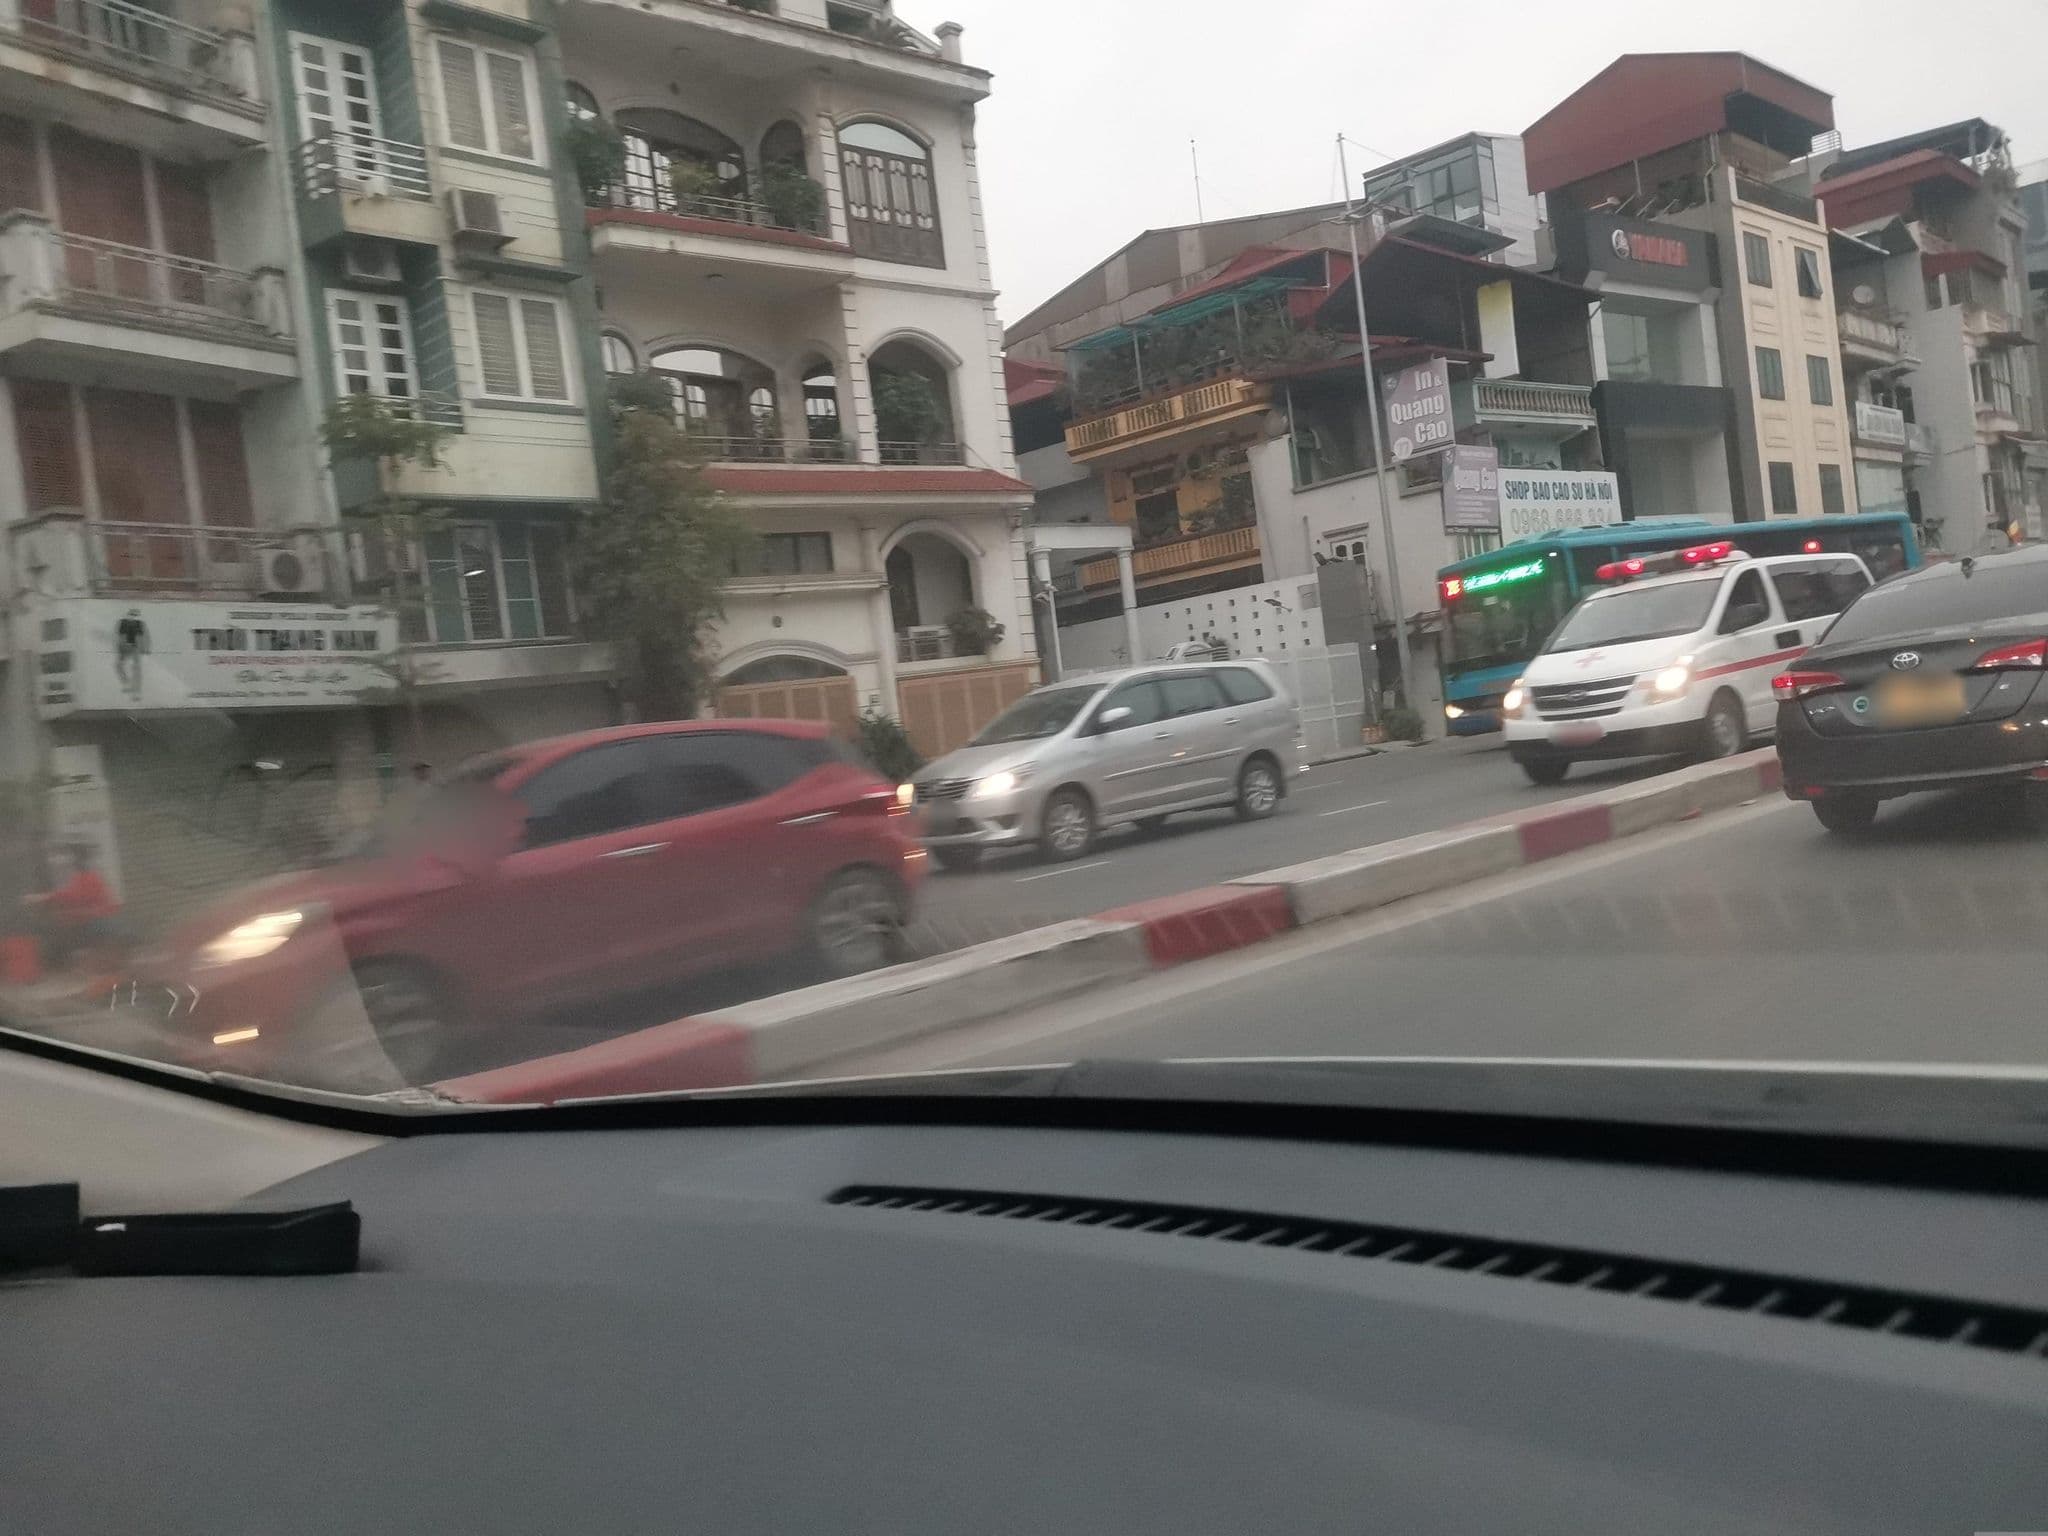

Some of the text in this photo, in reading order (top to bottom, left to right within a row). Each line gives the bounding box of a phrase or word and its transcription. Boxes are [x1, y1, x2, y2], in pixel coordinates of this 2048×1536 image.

[1414, 370, 1432, 391] In
[1504, 480, 1530, 500] SHOP
[1531, 481, 1551, 500] BAO
[1551, 481, 1570, 501] CAO
[1570, 482, 1584, 500] SU
